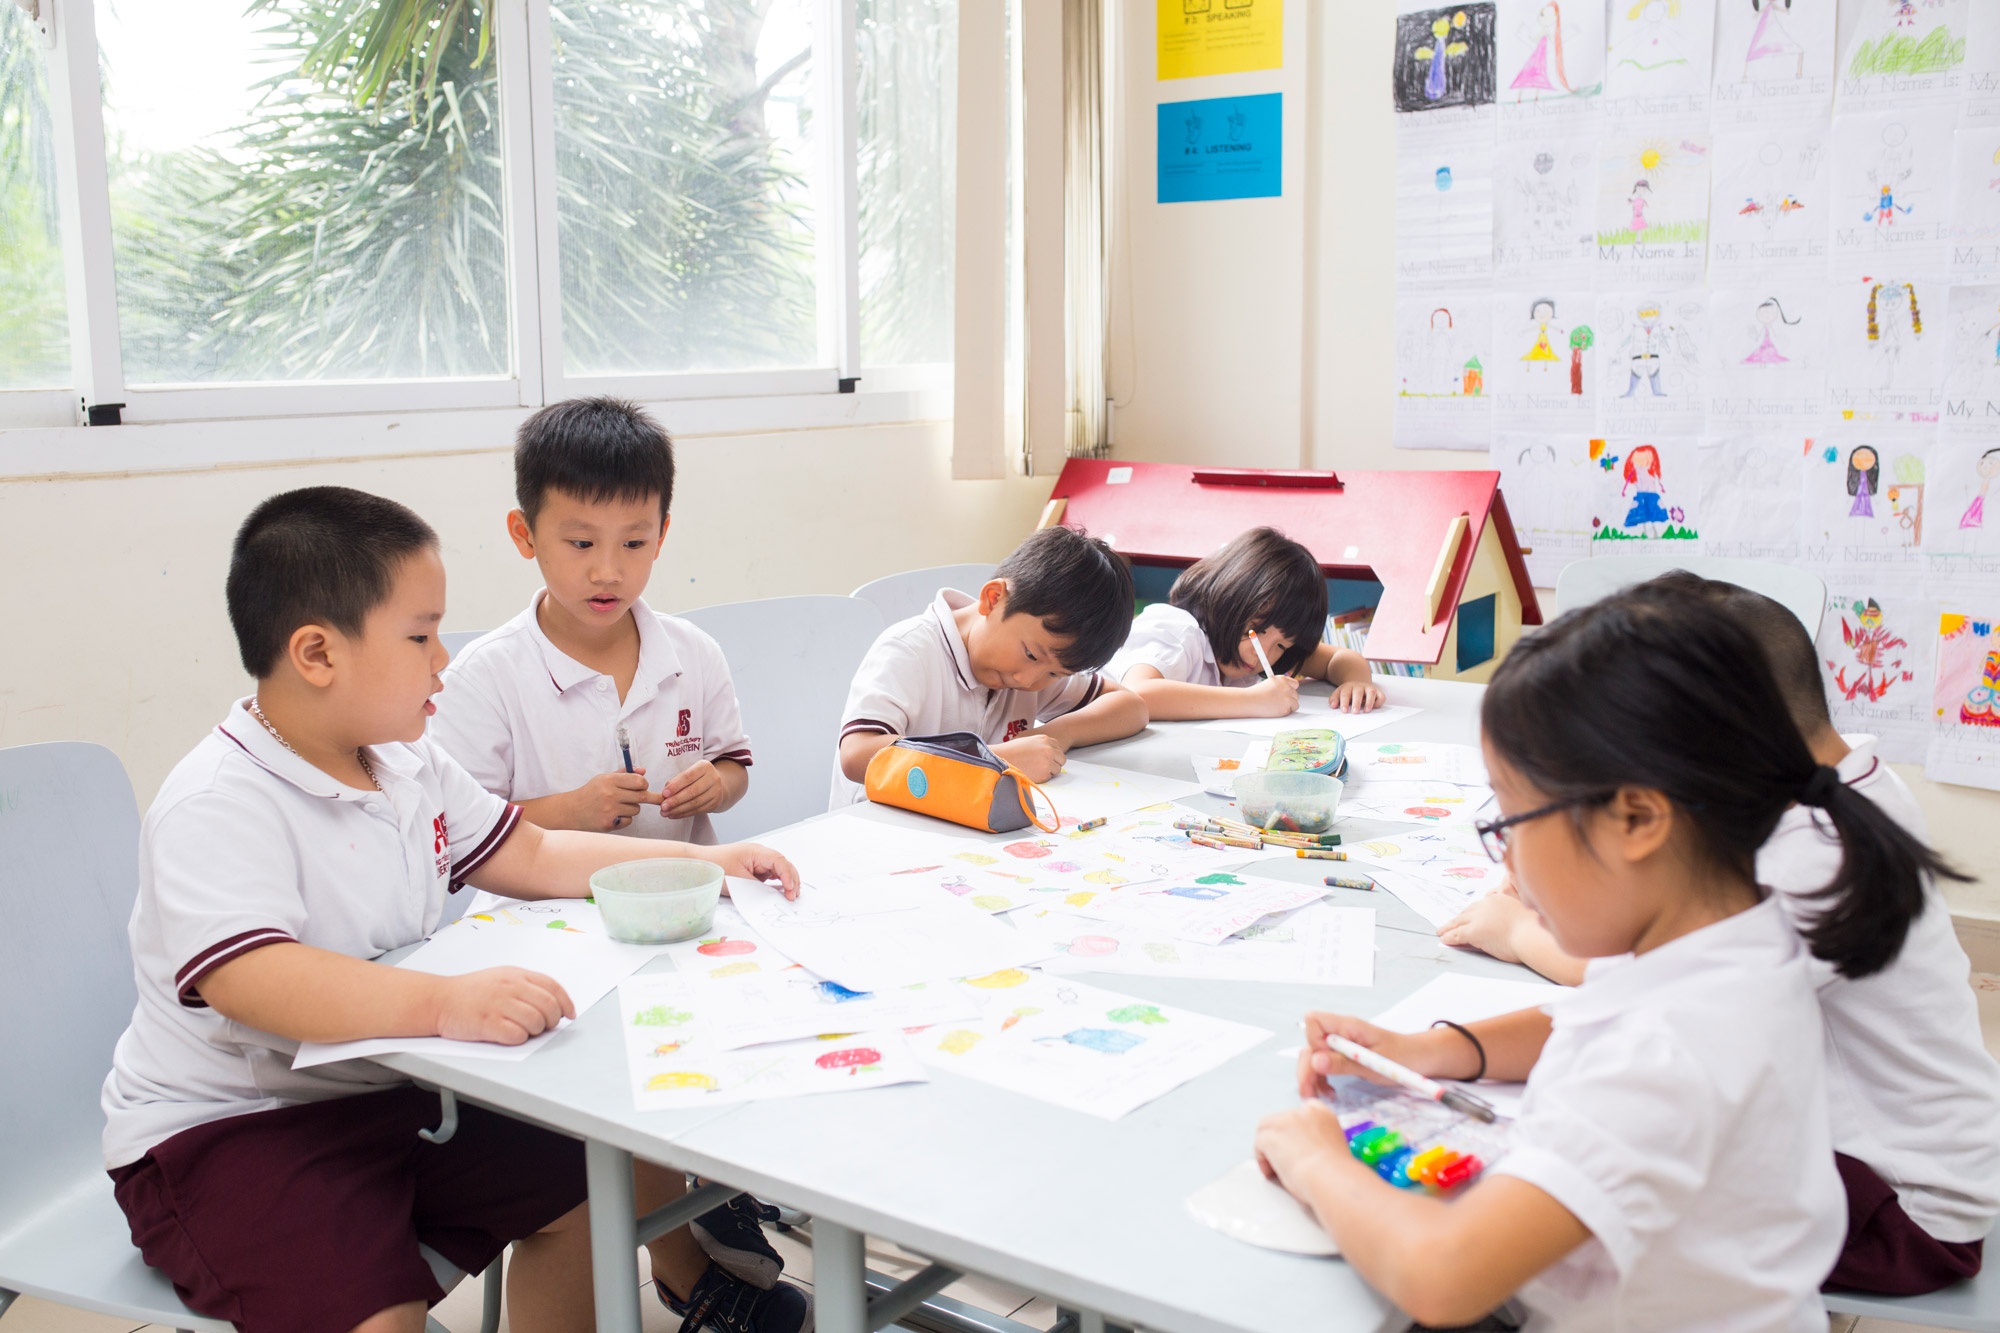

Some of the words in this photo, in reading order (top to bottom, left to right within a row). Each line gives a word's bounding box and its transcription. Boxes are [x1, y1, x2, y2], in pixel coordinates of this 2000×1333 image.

[1206, 9, 1251, 23] SPEAKING
[1716, 83, 1743, 102] My
[1752, 81, 1800, 98] Name
[1843, 79, 1870, 97] My
[1881, 75, 1933, 93] Name
[1634, 98, 1680, 115] Name
[1206, 142, 1252, 154] LISTENING
[1836, 228, 1863, 249] My
[1874, 225, 1926, 244] Name
[1600, 244, 1623, 264] My
[1631, 241, 1675, 260] Name
[1715, 242, 1741, 262] My
[1750, 240, 1799, 259] Name
[1954, 246, 1982, 267] My
[1429, 259, 1467, 275] Name
[1526, 393, 1570, 409] Name
[1632, 396, 1676, 414] Name
[1831, 387, 1858, 407] My
[1868, 386, 1919, 406] Name
[1712, 398, 1737, 418] My
[1747, 397, 1794, 417] Name
[1946, 400, 1975, 420] My
[1738, 541, 1784, 558] Name
[1807, 545, 1834, 564] My
[1843, 544, 1894, 564] Name
[1930, 554, 1958, 576] My
[1851, 701, 1900, 721] Name
[1938, 722, 1966, 744] My
